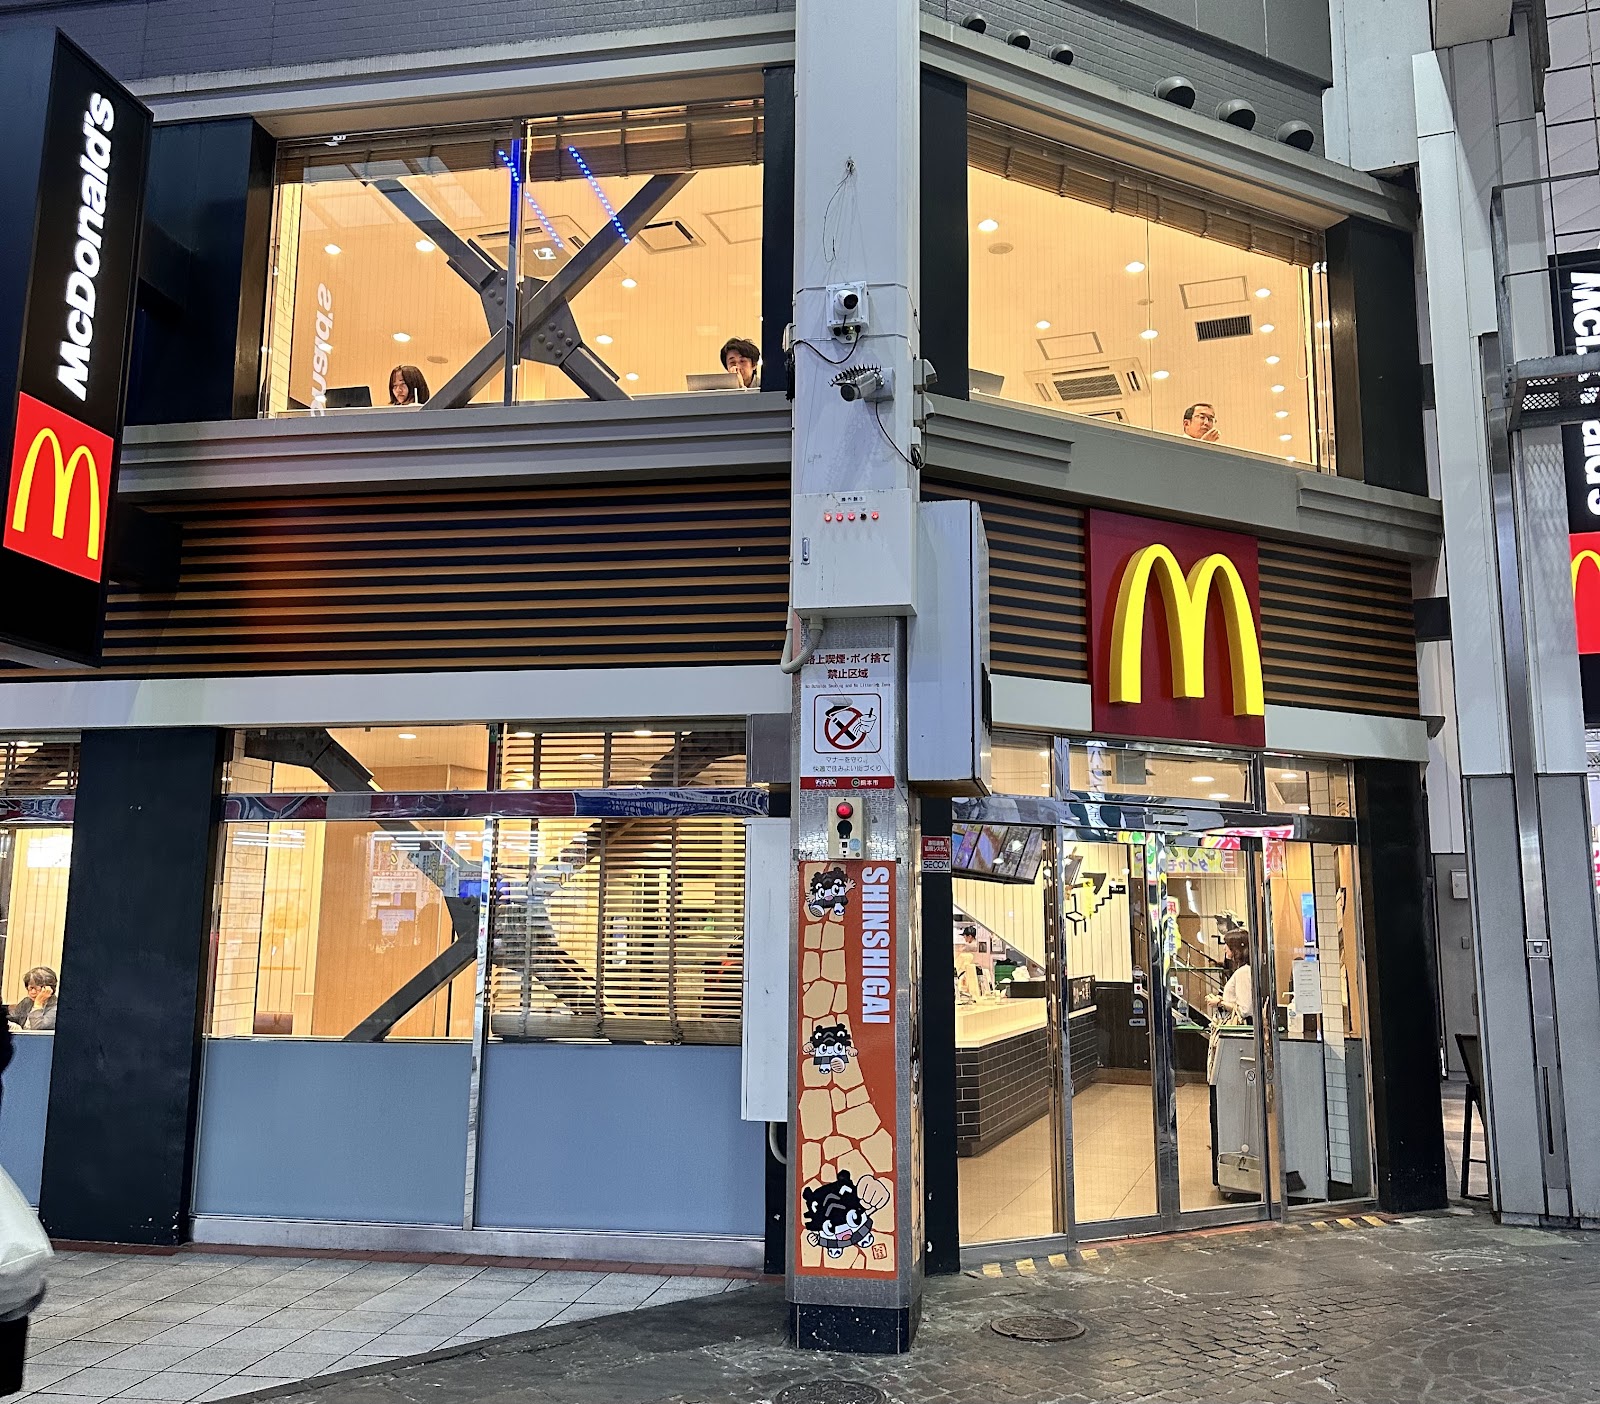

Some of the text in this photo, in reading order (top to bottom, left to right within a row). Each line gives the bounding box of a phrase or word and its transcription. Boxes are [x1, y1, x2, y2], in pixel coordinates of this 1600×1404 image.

[57, 91, 117, 402] McDonald's
[827, 668, 869, 679] 禁止区域
[924, 860, 950, 868] SECOM
[861, 866, 891, 1025] SHINSHIGAI
